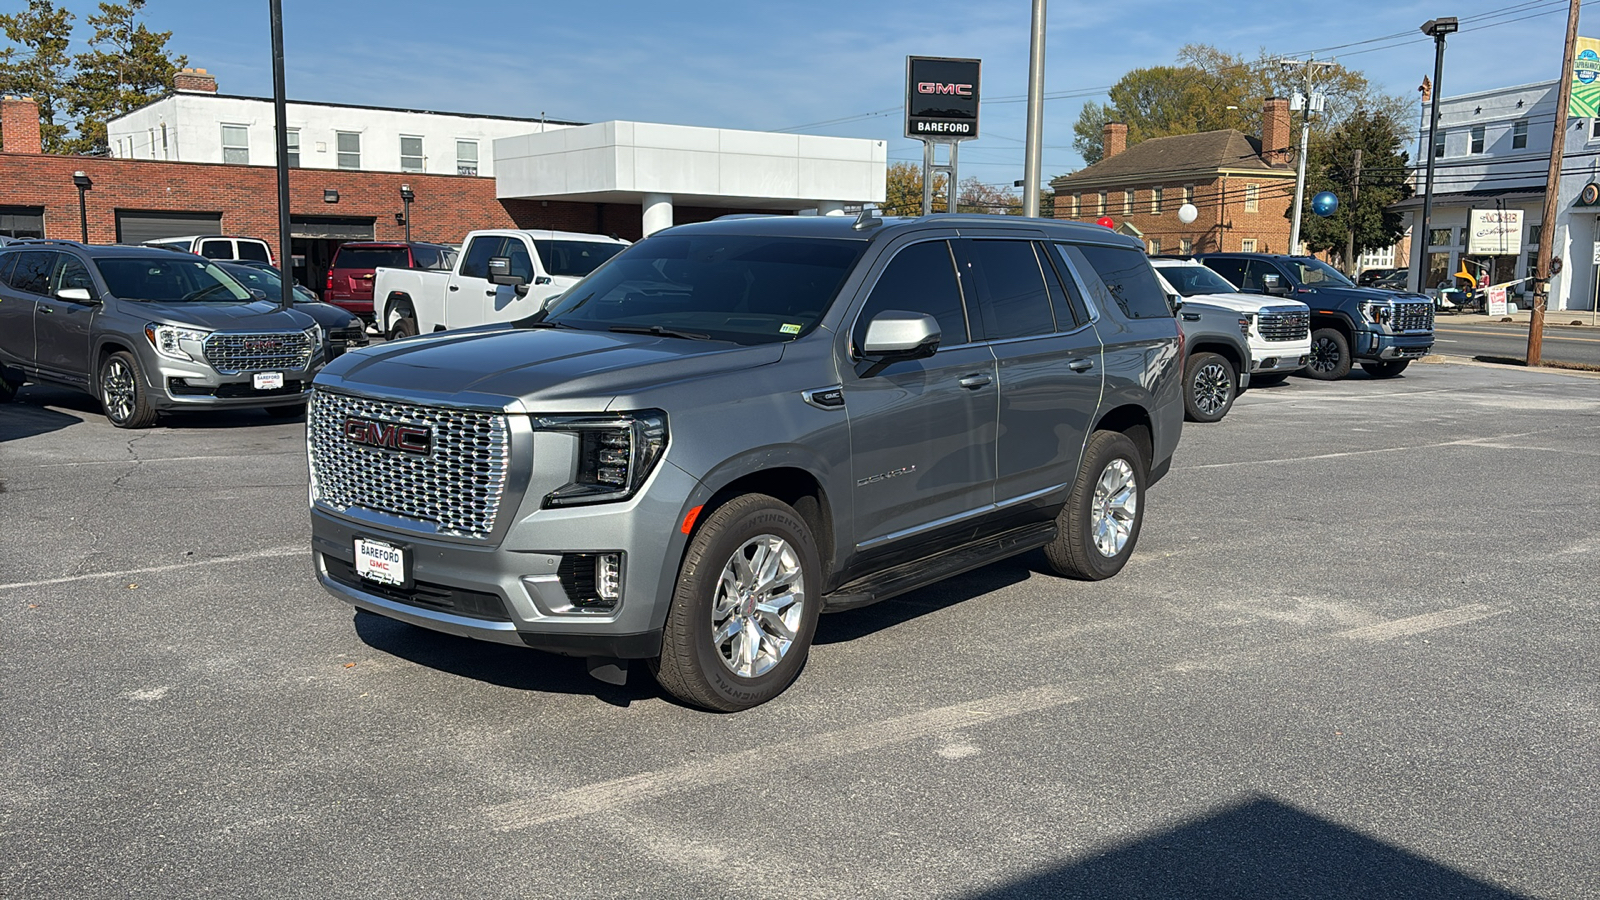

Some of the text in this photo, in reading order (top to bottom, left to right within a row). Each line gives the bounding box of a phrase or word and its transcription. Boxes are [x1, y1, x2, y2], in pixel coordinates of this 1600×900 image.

[918, 82, 972, 95] GMC
[917, 122, 970, 132] BAREFORD
[345, 419, 428, 453] GMC
[857, 465, 916, 487] DENALI
[361, 545, 399, 563] BAREFORD
[370, 559, 389, 570] GMC
